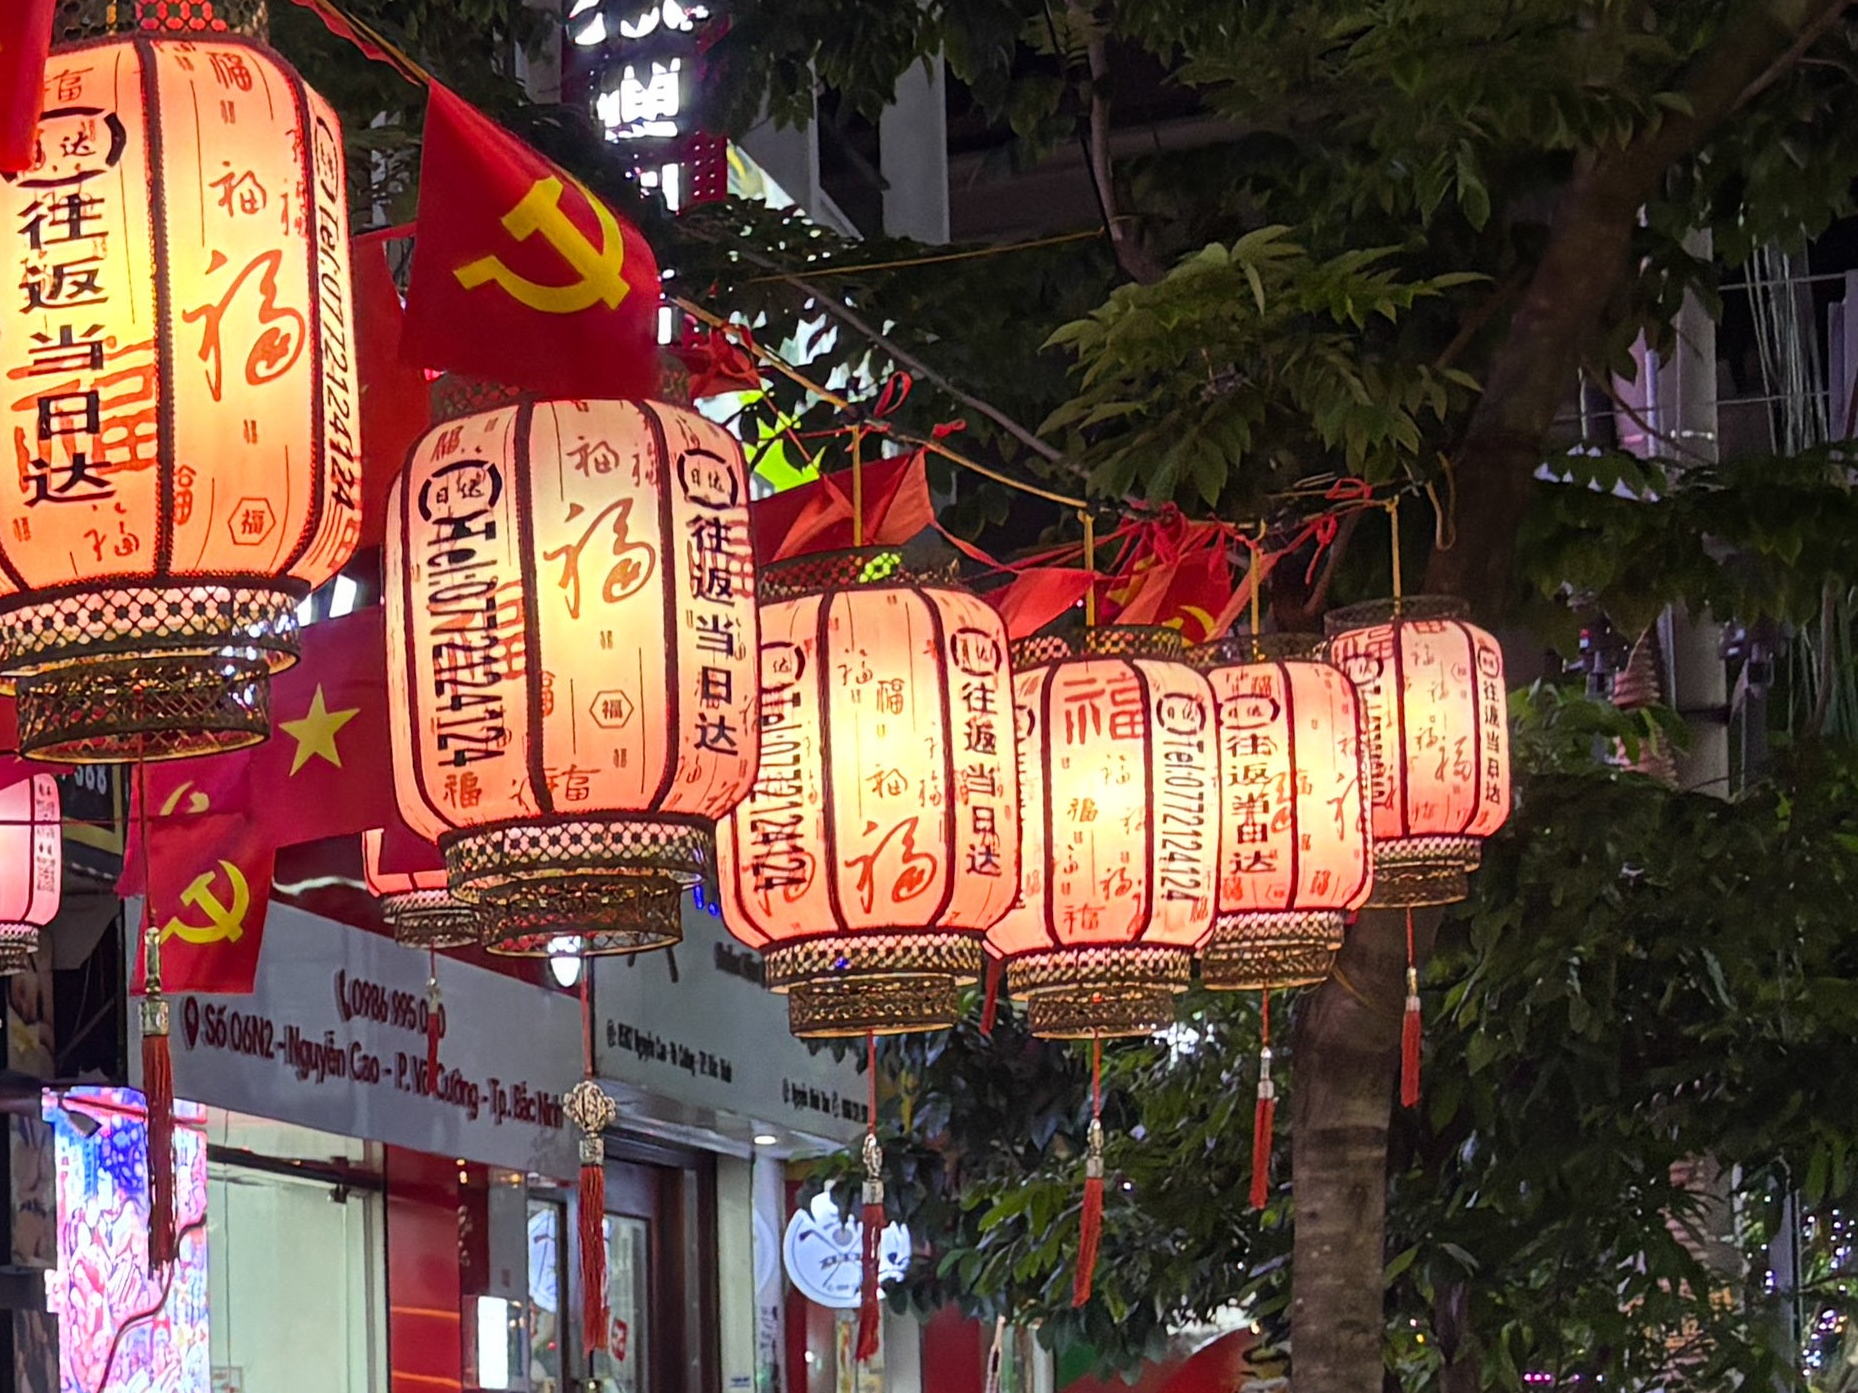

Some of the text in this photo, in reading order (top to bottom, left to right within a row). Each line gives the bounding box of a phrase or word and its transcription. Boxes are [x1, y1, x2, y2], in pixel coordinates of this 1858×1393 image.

[17, 189, 119, 508] 往返当日达
[689, 513, 741, 758] 往返当日达
[204, 1004, 227, 1047] Số
[348, 1041, 380, 1084] Cao
